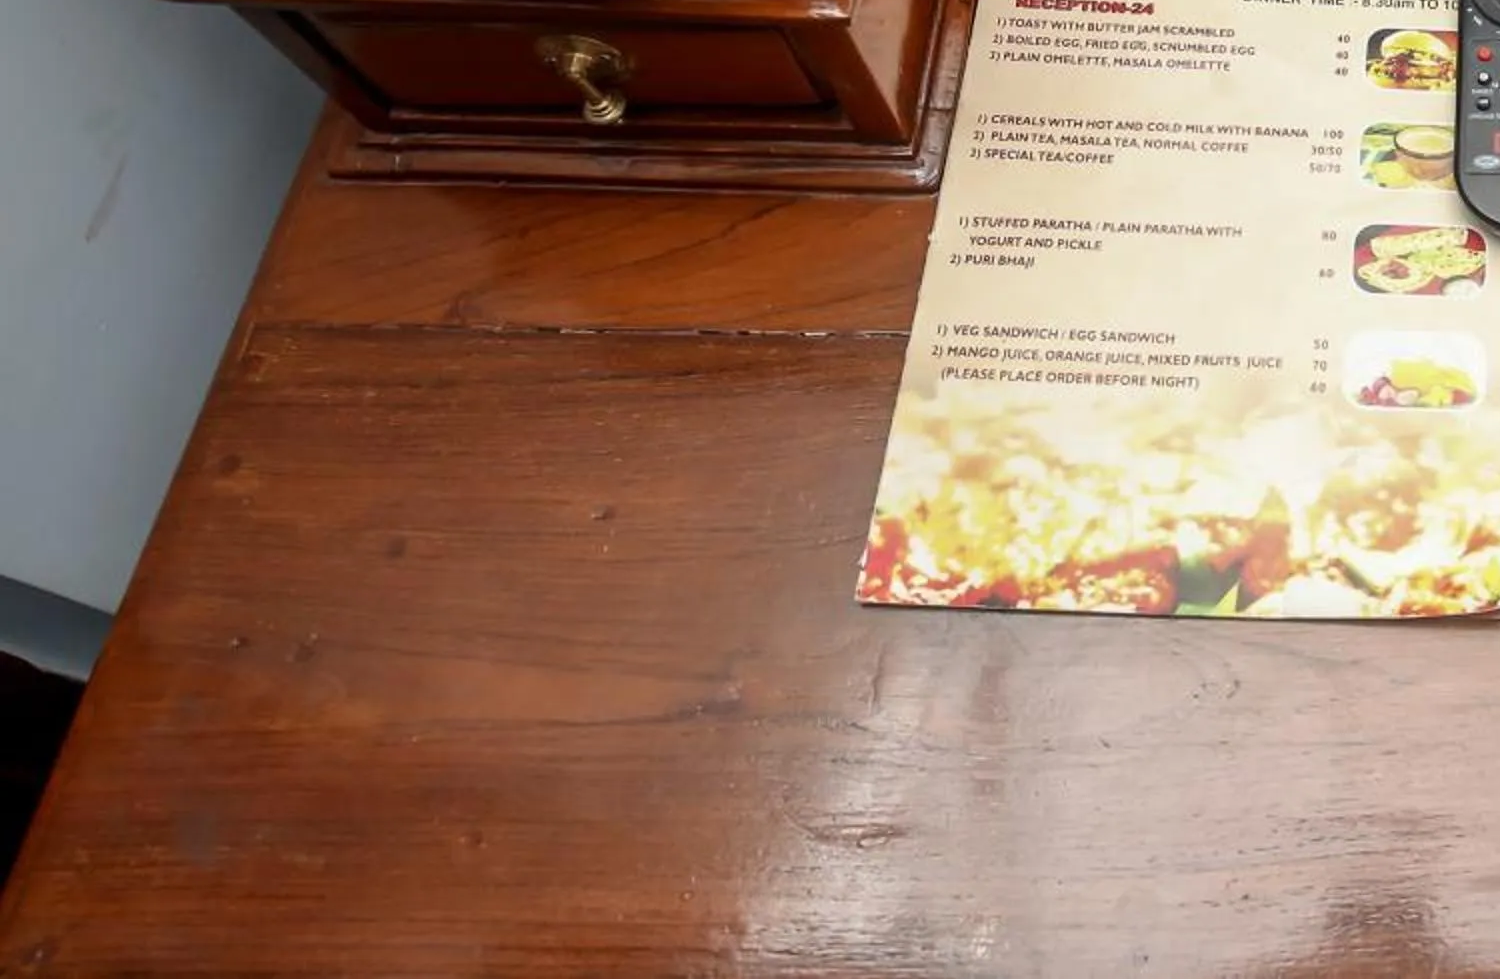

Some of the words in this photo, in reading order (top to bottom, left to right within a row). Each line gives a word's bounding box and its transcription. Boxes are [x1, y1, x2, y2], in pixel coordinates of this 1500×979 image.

[1009, 18, 1047, 30] TOAST
[1050, 20, 1085, 32] WITH
[1087, 22, 1134, 34] BUTTER
[1136, 24, 1160, 36] JAM
[1163, 25, 1235, 38] SCRAMBLED
[1006, 35, 1051, 47] BOILED
[1085, 38, 1119, 50] FRIED
[1230, 44, 1256, 56] EGG
[1003, 52, 1040, 63] PLAIN
[1113, 56, 1163, 68] MASALA
[1166, 58, 1231, 71] OMELETTE
[991, 114, 1047, 127] CEREALS
[1048, 118, 1083, 130] WITH
[1086, 119, 1113, 131] HOT
[1114, 121, 1143, 132] AND
[1146, 122, 1182, 133] COLD
[1184, 123, 1216, 135] MILK
[1216, 124, 1252, 136] WITH
[1254, 126, 1309, 138] BANANA
[991, 131, 1029, 142] PLAIN
[1060, 134, 1111, 147] MASALA
[1143, 139, 1197, 151] NORMAL
[1200, 141, 1249, 154] COFFEE
[984, 148, 1035, 161] SPECIAL
[972, 216, 1030, 229] STUFFED
[1032, 219, 1092, 232] PARATHA
[1102, 222, 1141, 234] PLAIN
[1143, 223, 1203, 236] PARATHA
[1205, 225, 1243, 237] WITH
[969, 236, 1022, 248] YOGURT
[1024, 237, 1054, 249] AND
[1057, 238, 1103, 250] PICKLE
[964, 254, 994, 266] PURI
[998, 255, 1035, 269] BHAJI
[952, 325, 980, 337] VEG
[983, 326, 1059, 341] SANDWICH
[1068, 329, 1097, 342] EGG
[1100, 331, 1176, 344] SANDWICH
[947, 346, 1000, 359] MANGO
[1045, 350, 1102, 363] ORANGE
[1148, 354, 1190, 366] MIXED
[1193, 355, 1241, 367] FRUITS
[1246, 357, 1284, 370] JUICE
[941, 366, 995, 381] (PLEASE
[1000, 369, 1042, 382] PLACE
[1046, 371, 1092, 384] ORDER
[1095, 373, 1147, 386] BEFORE
[1151, 376, 1200, 390] NIGHT)
